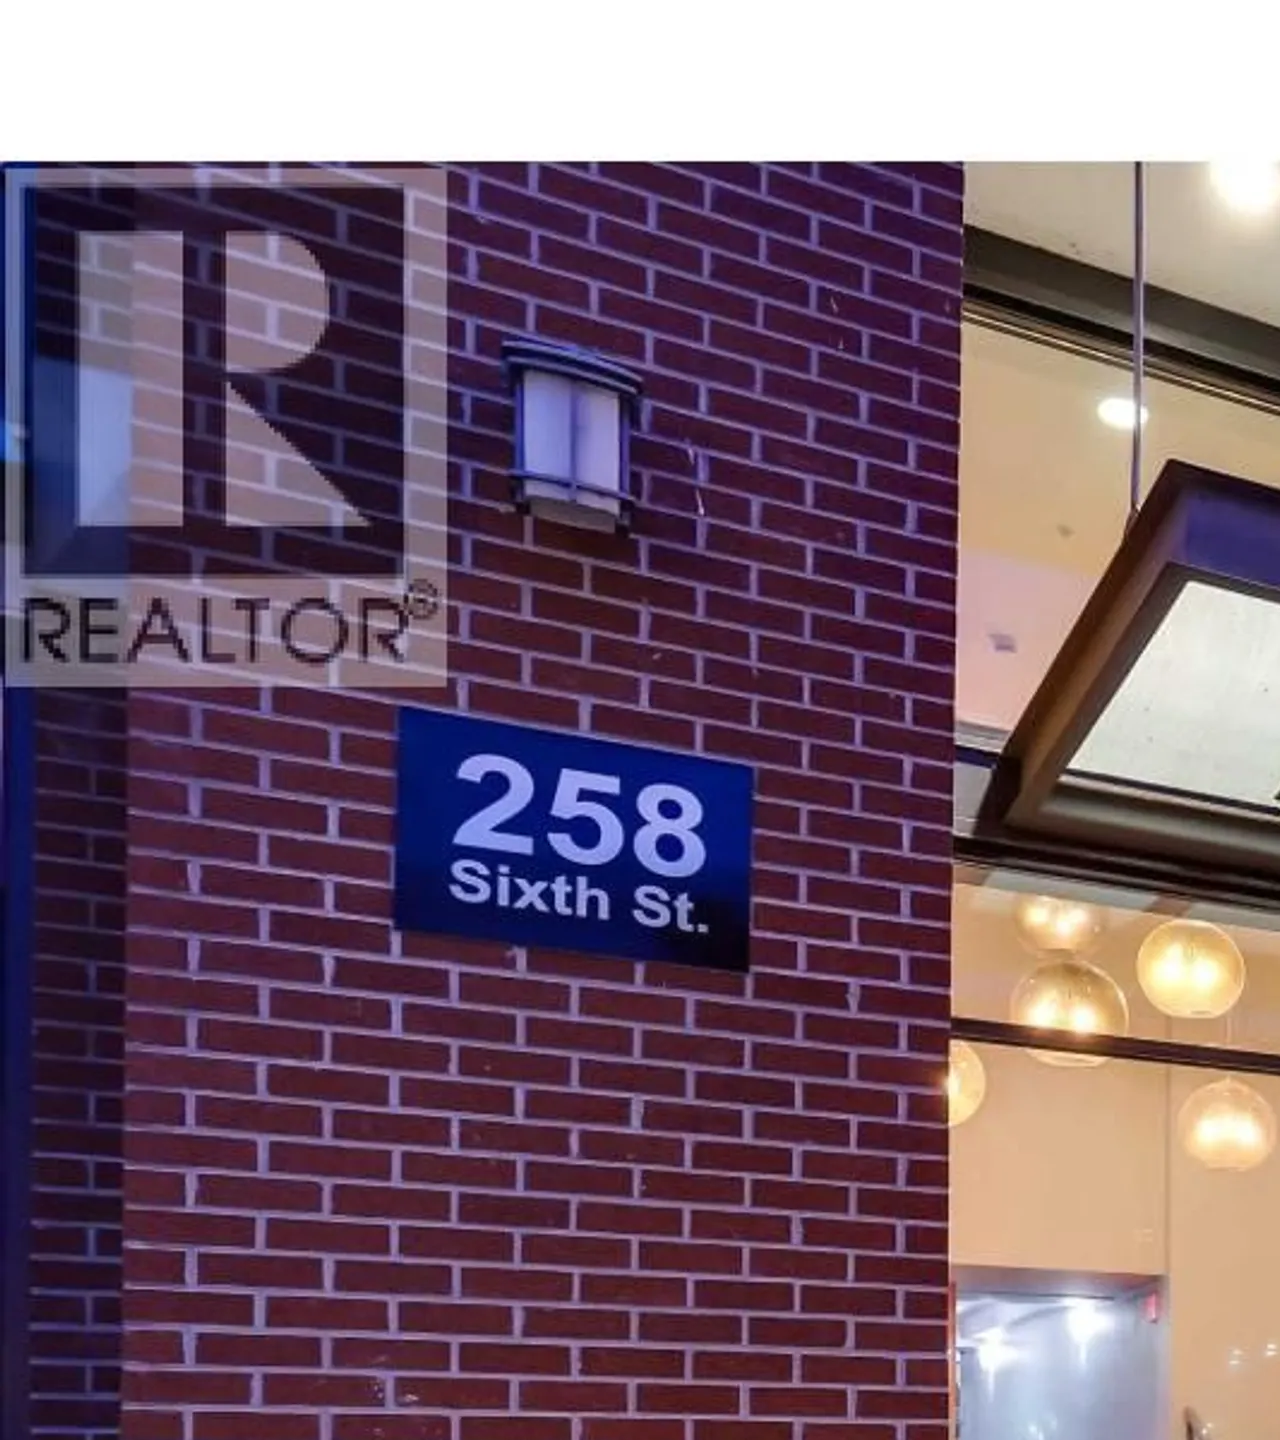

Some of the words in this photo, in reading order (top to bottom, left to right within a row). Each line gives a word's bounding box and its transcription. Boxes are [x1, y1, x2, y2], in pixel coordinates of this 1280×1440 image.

[453, 754, 706, 878] 258
[450, 859, 611, 921] Sixth
[632, 885, 709, 934] St.
